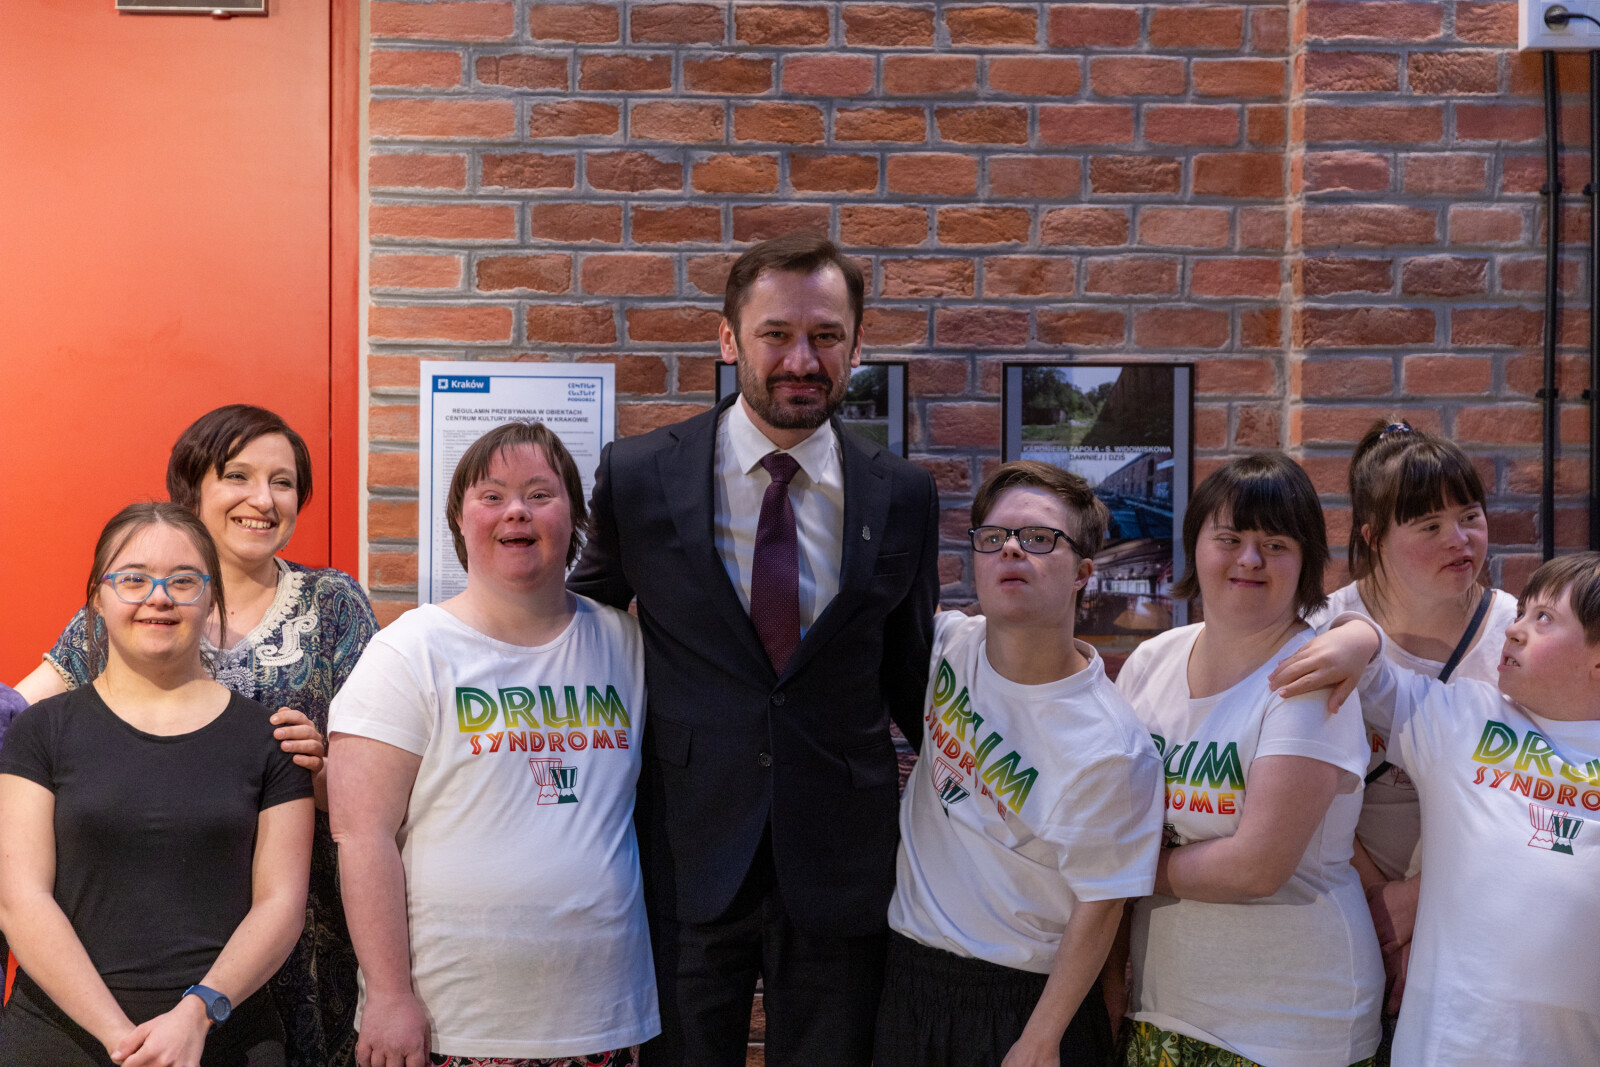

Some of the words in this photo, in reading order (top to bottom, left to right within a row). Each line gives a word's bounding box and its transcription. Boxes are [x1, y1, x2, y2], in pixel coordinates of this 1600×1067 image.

[451, 379, 484, 389] Kraków
[1108, 452, 1126, 461] DZIŚ
[455, 684, 632, 733] DRUM
[470, 729, 630, 755] SYNDROME
[1471, 719, 1600, 787] DRU
[1472, 766, 1600, 812] SYNDRO
